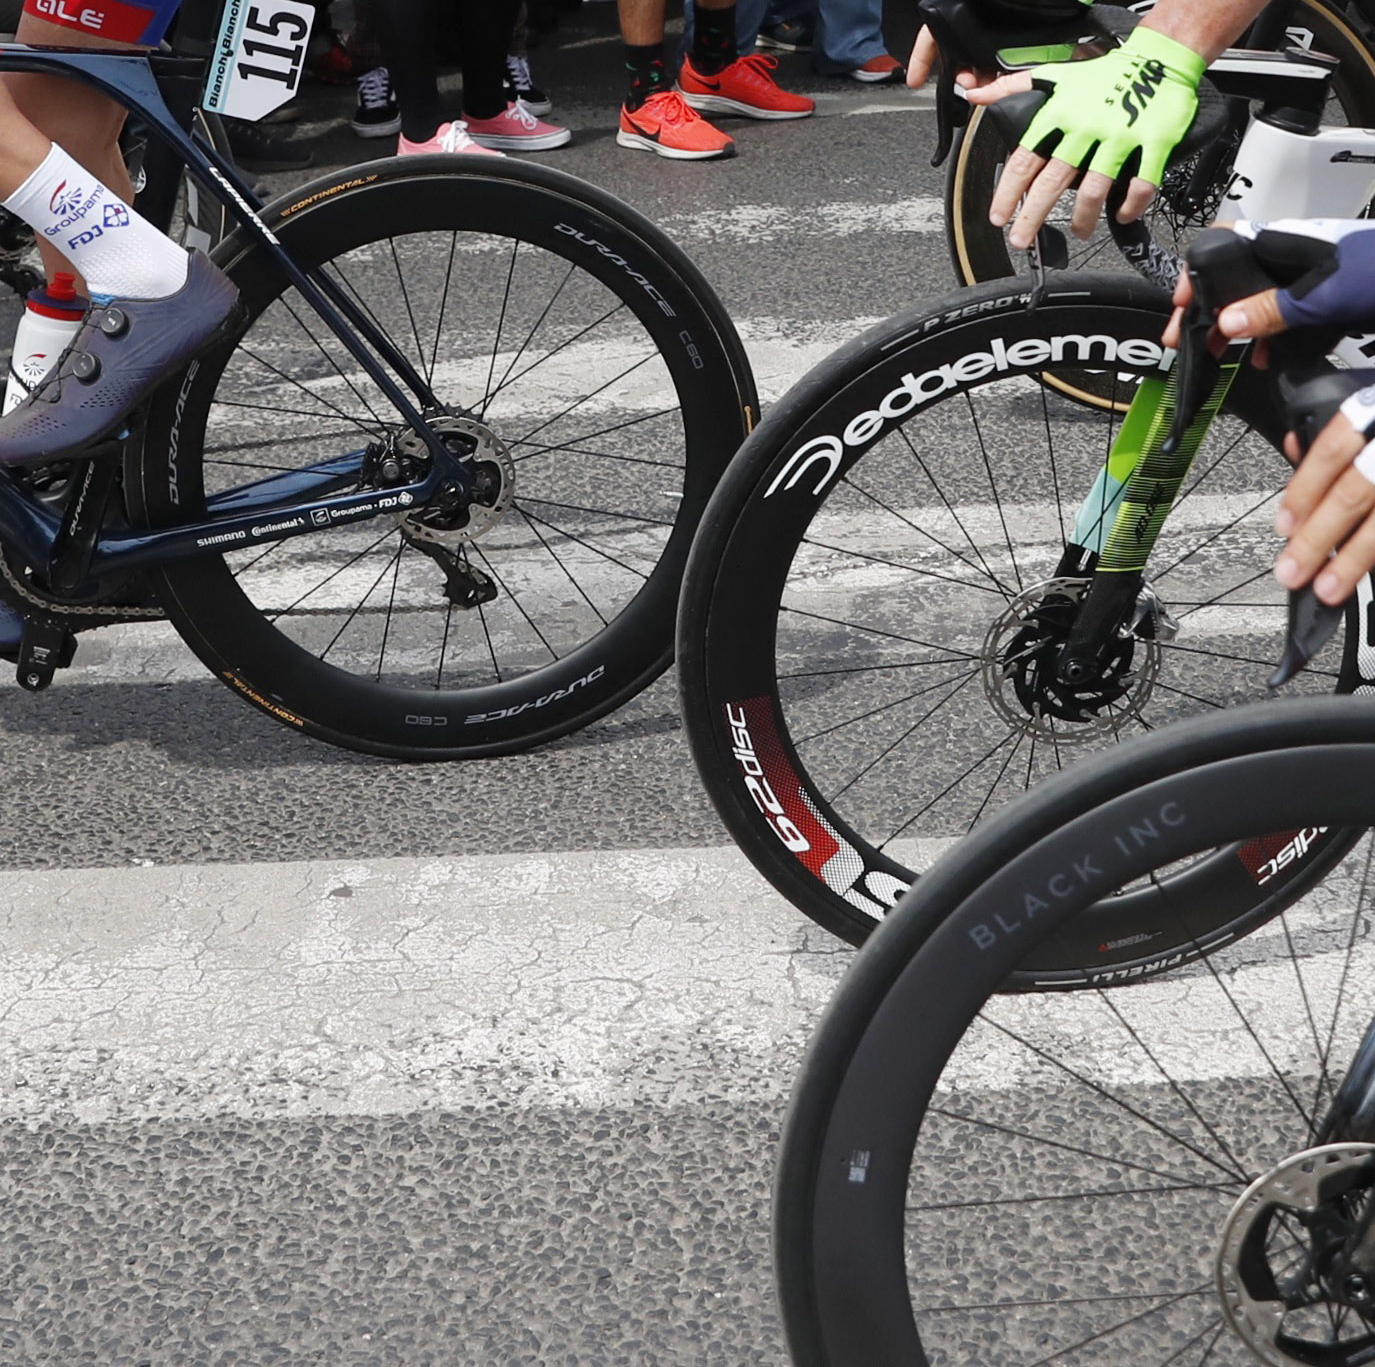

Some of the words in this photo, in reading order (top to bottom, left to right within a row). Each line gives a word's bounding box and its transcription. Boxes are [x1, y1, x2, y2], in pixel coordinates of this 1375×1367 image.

[238, 6, 309, 91] 115
[44, 184, 105, 237] Groupama
[208, 165, 281, 245] LAPIERRE
[290, 176, 367, 215] CONTINENTAL
[67, 220, 104, 250] FDJ
[554, 223, 677, 318] DURA-ACE
[924, 316, 940, 331] P
[945, 297, 1014, 323] ZERO
[679, 329, 705, 370] C60
[167, 359, 201, 506] DURA-ACE
[197, 529, 246, 548] SHIMANO
[251, 517, 299, 537] Continental
[331, 501, 374, 519] Groupama
[378, 496, 399, 509] FDJ
[464, 664, 607, 725] DURA-ACE
[726, 702, 811, 854] 62disc
[968, 854, 1102, 951] BLACK
[1114, 801, 1187, 857] INC
[1257, 826, 1330, 886] disc
[1091, 952, 1184, 983] PIRELLI
